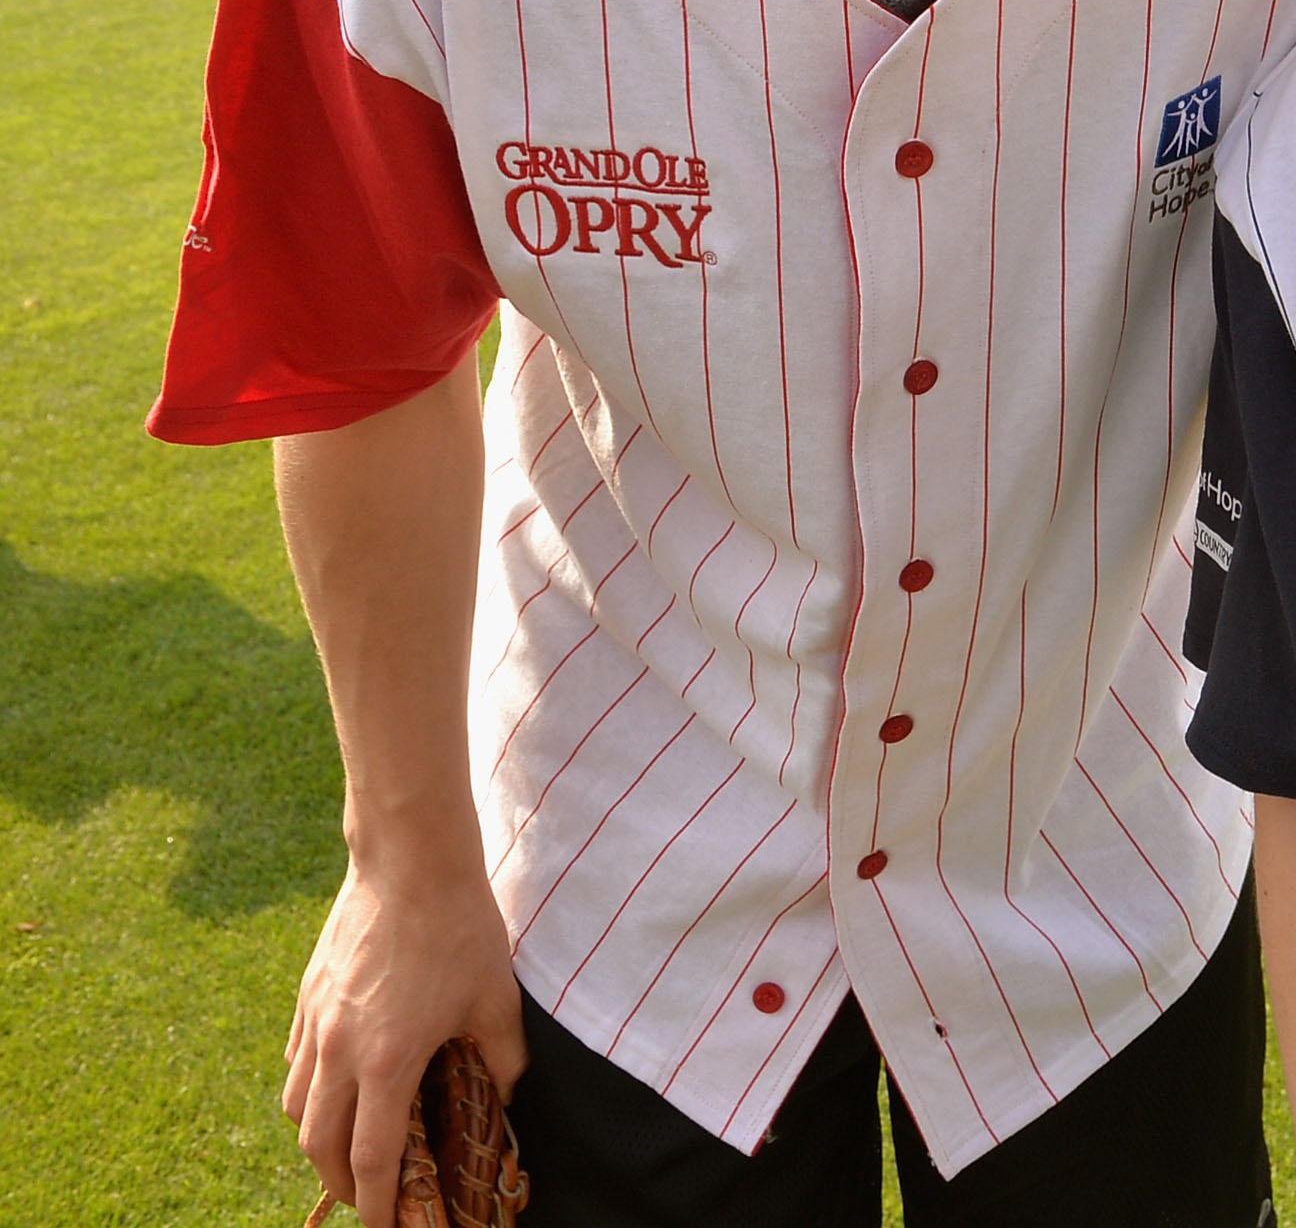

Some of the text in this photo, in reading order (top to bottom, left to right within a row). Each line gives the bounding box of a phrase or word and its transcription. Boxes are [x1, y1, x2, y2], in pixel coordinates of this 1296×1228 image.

[495, 141, 709, 190] GRAND OLE
[1149, 180, 1211, 224] Hope
[504, 183, 713, 268] OPRY
[1199, 528, 1233, 569] COUNTRY
